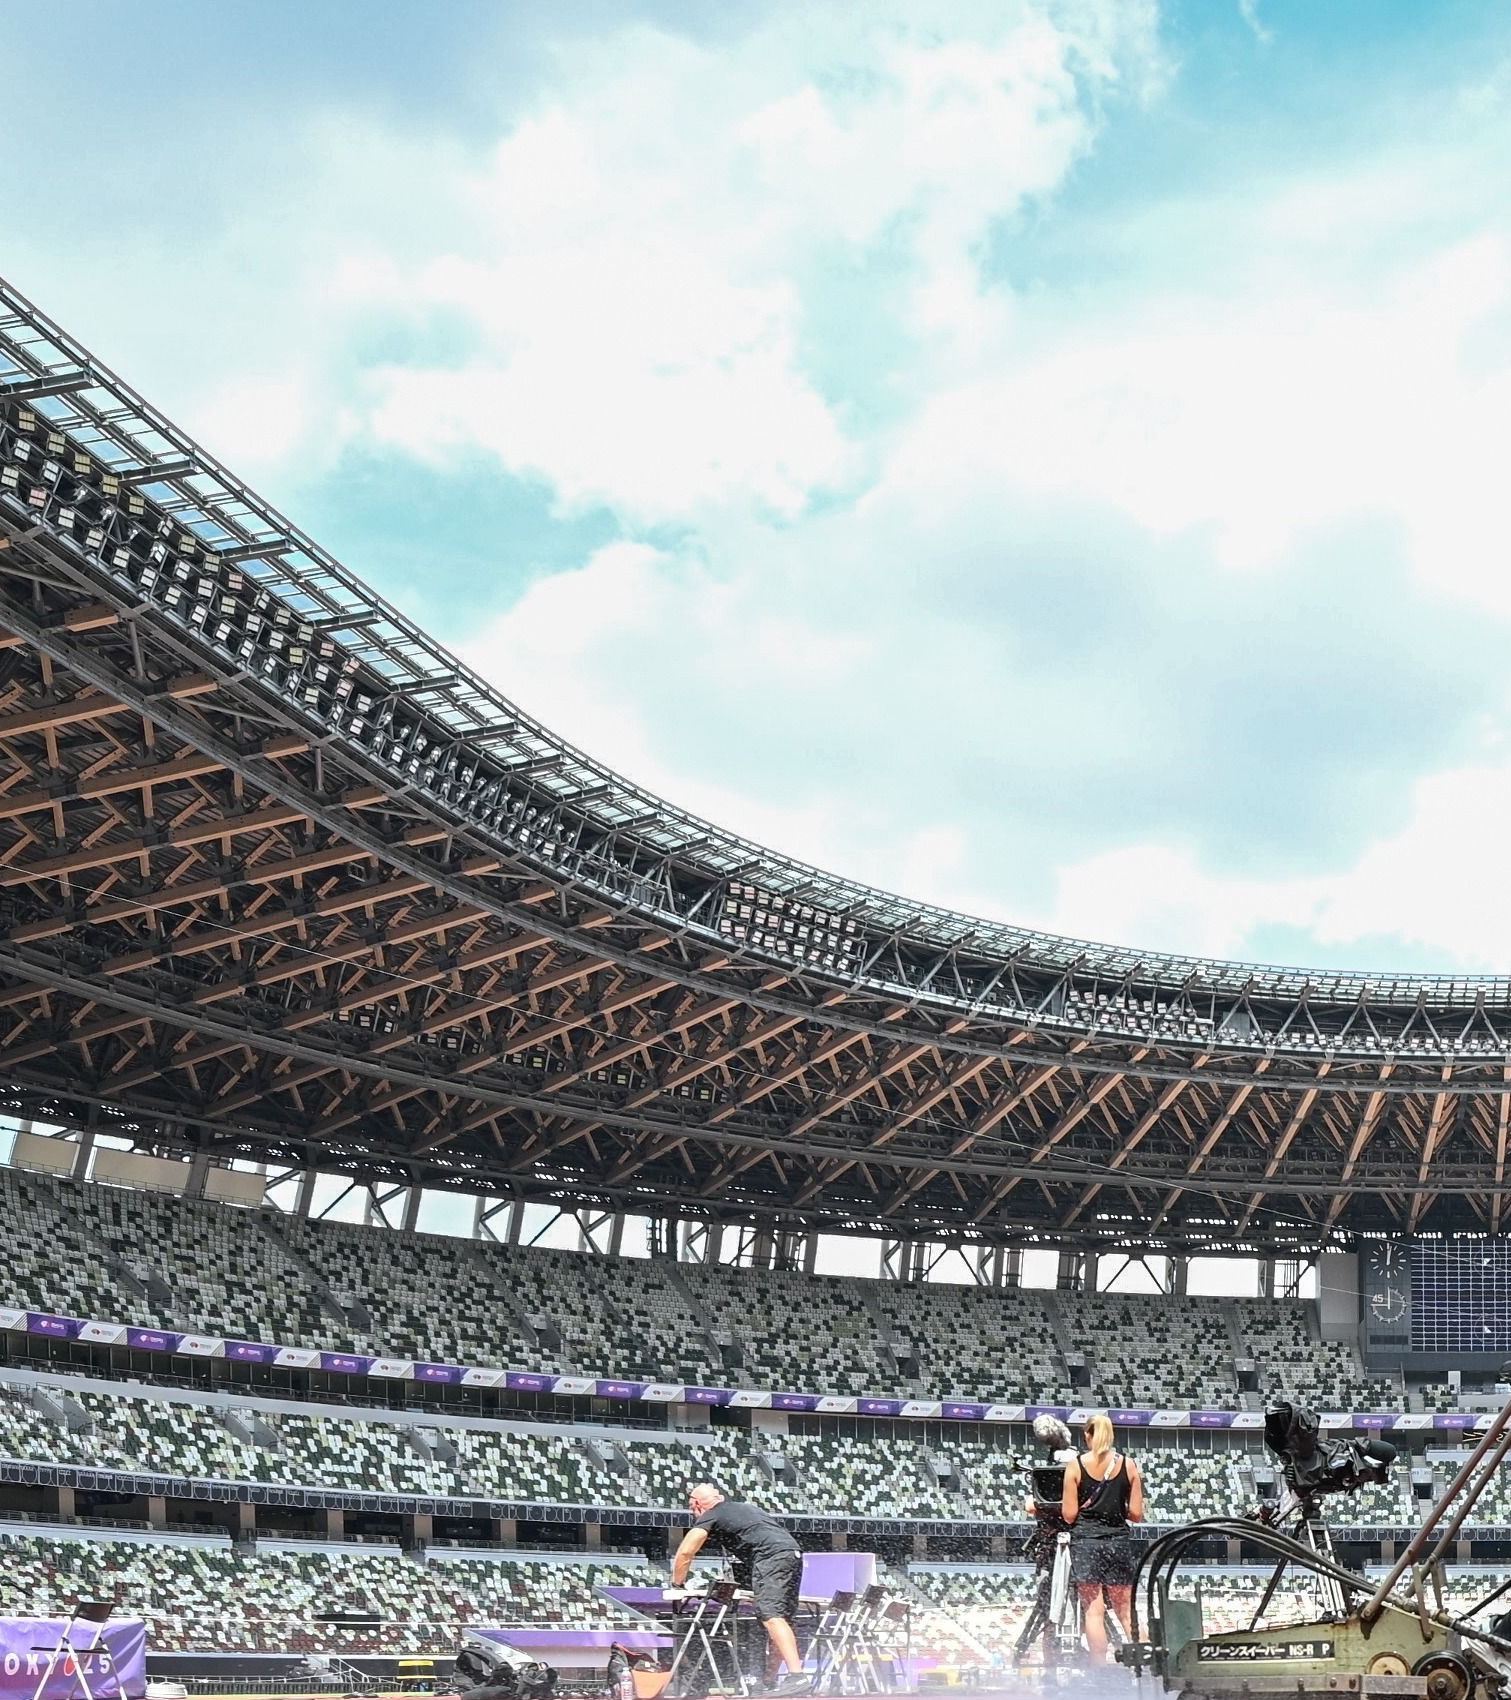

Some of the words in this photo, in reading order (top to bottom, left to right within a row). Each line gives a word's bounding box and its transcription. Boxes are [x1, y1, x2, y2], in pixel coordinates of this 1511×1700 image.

[1372, 1293, 1385, 1304] 45
[1289, 1645, 1314, 1656] NS-R
[1322, 1643, 1331, 1656] P
